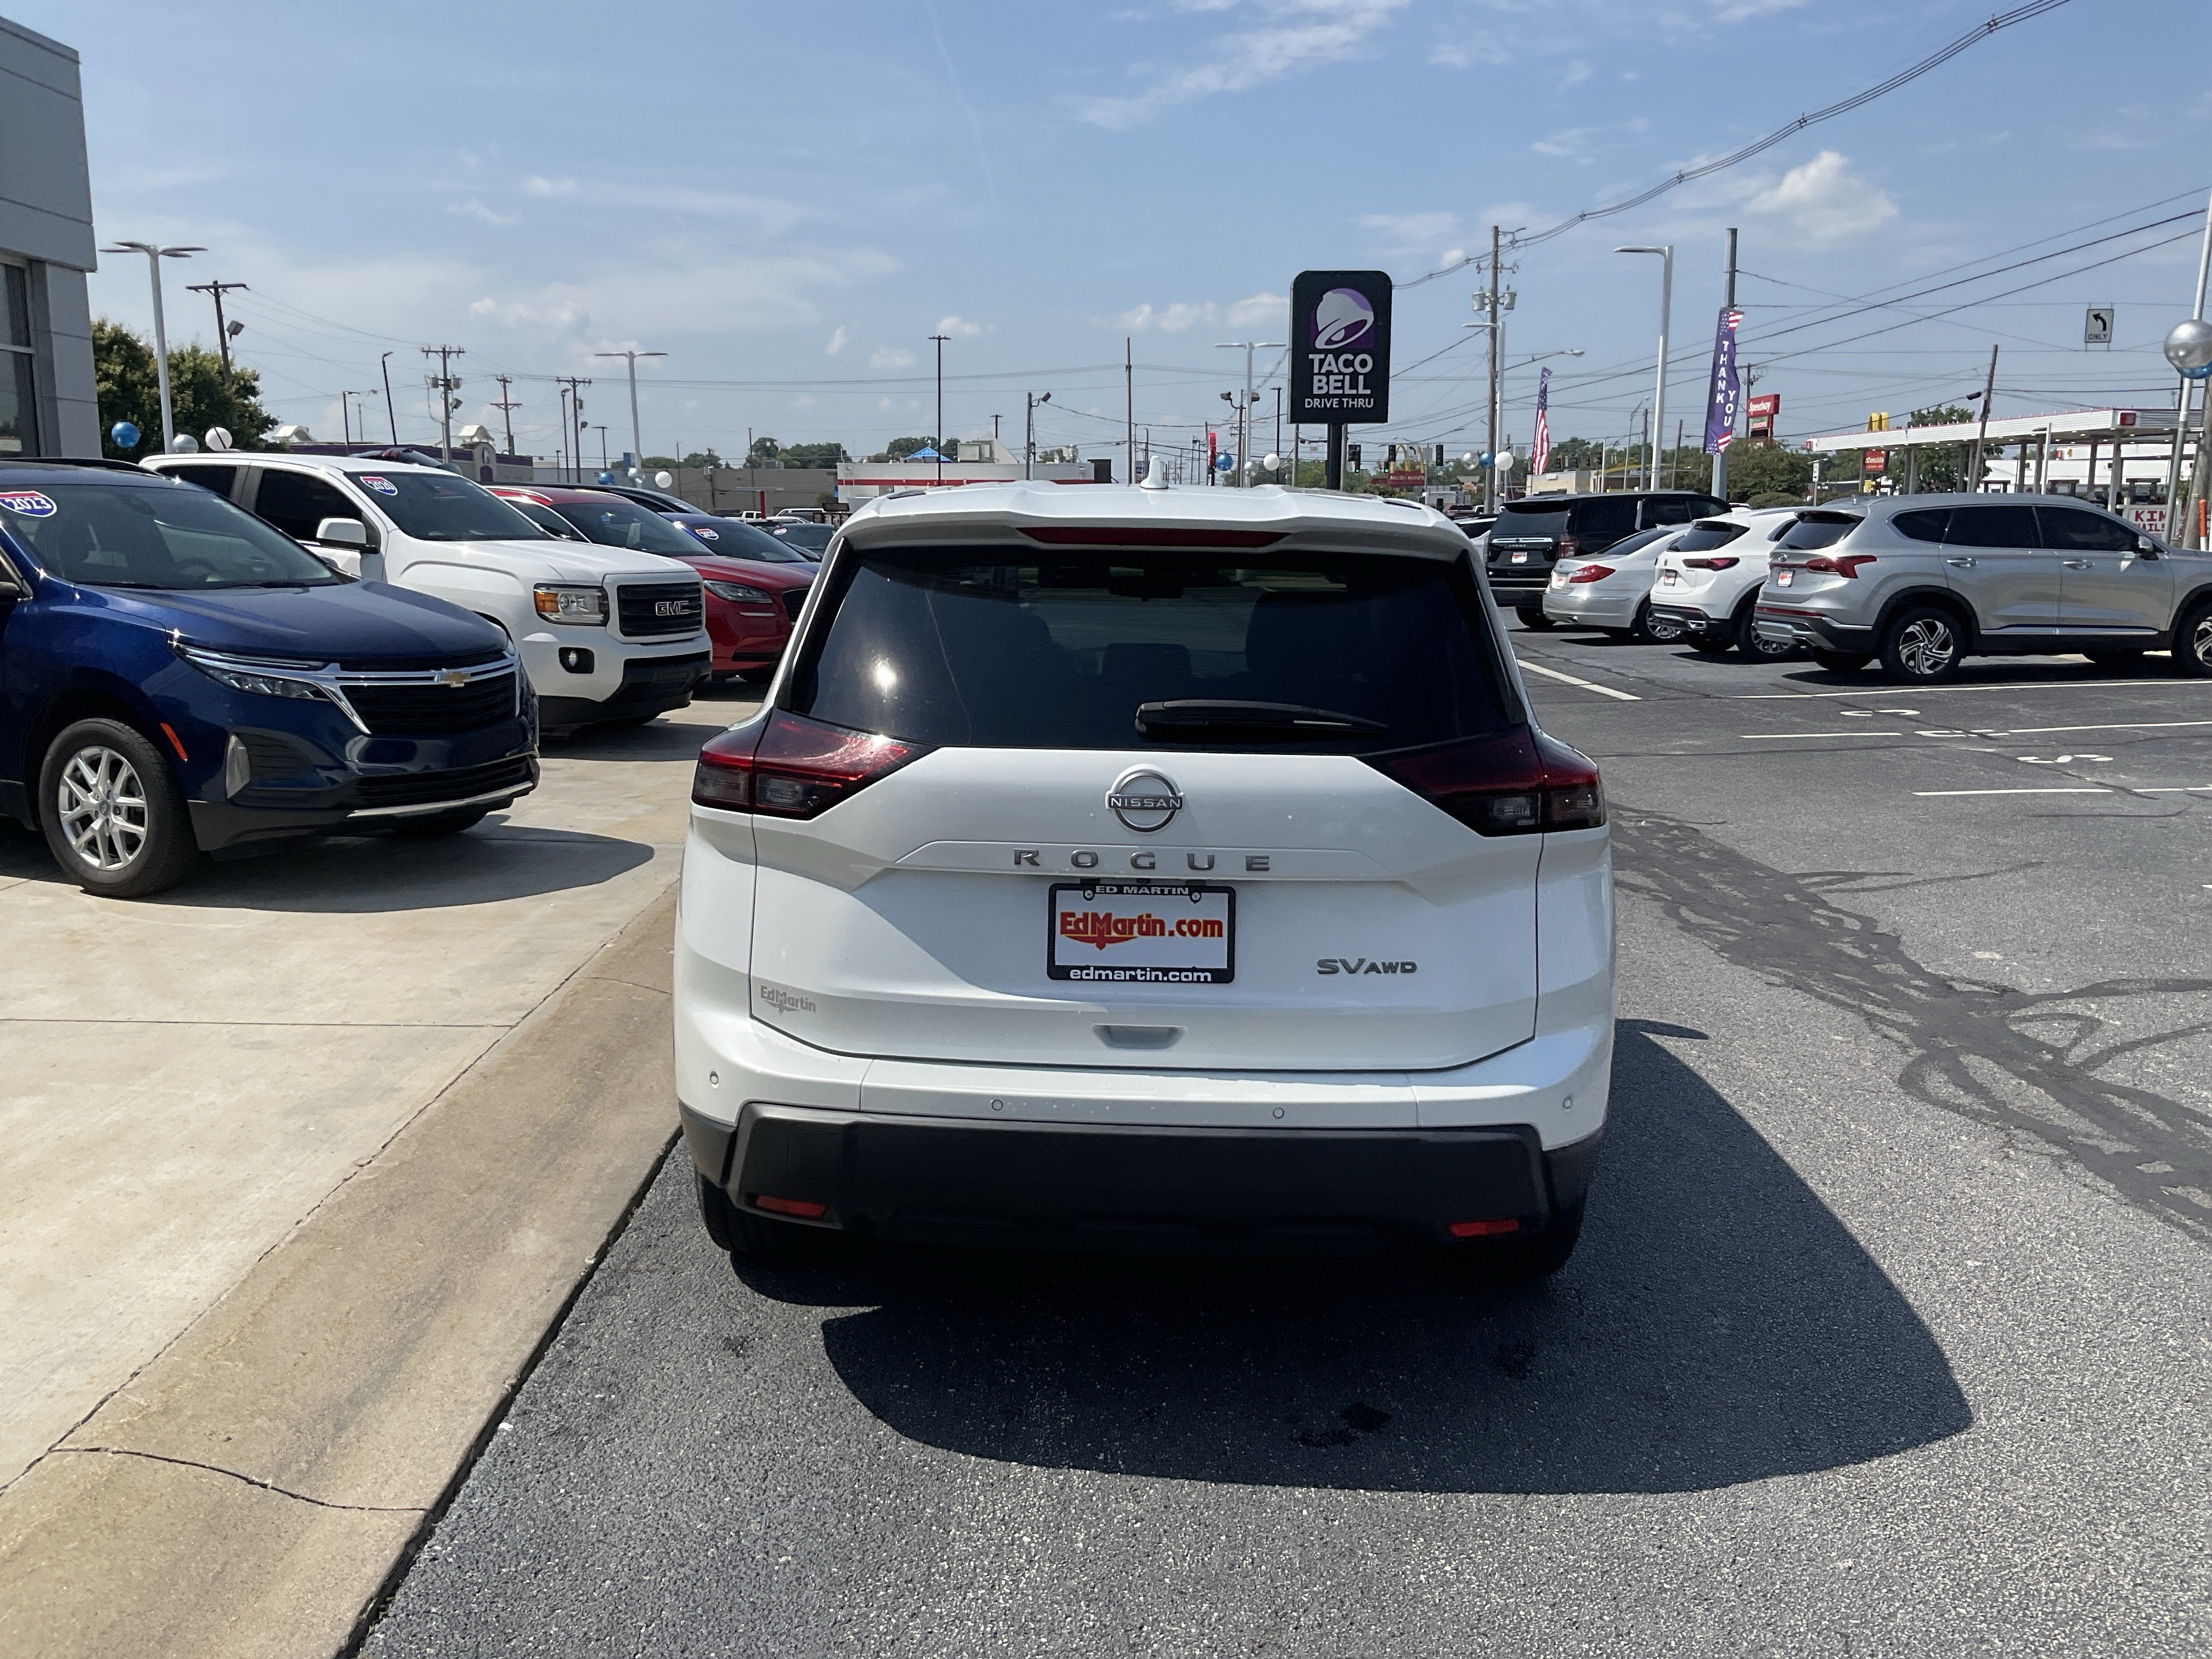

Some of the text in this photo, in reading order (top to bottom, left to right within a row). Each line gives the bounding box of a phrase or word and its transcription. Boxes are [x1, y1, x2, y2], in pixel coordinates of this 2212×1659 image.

[1308, 353, 1373, 373] TACO
[1716, 341, 1729, 403] THANK
[1313, 375, 1371, 394] BELL
[1305, 398, 1374, 408] DRIVE THRU
[1724, 390, 1736, 427] YOU
[4, 497, 53, 510] 2023
[656, 601, 689, 616] GMC
[1110, 797, 1180, 808] NISSAN
[1013, 848, 1270, 871] ROGUE
[1096, 885, 1189, 895] ED MARTIN
[1060, 911, 1223, 938] EdMartin.com
[1070, 967, 1211, 981] edmartin.com
[760, 985, 816, 1013] EdMartin
